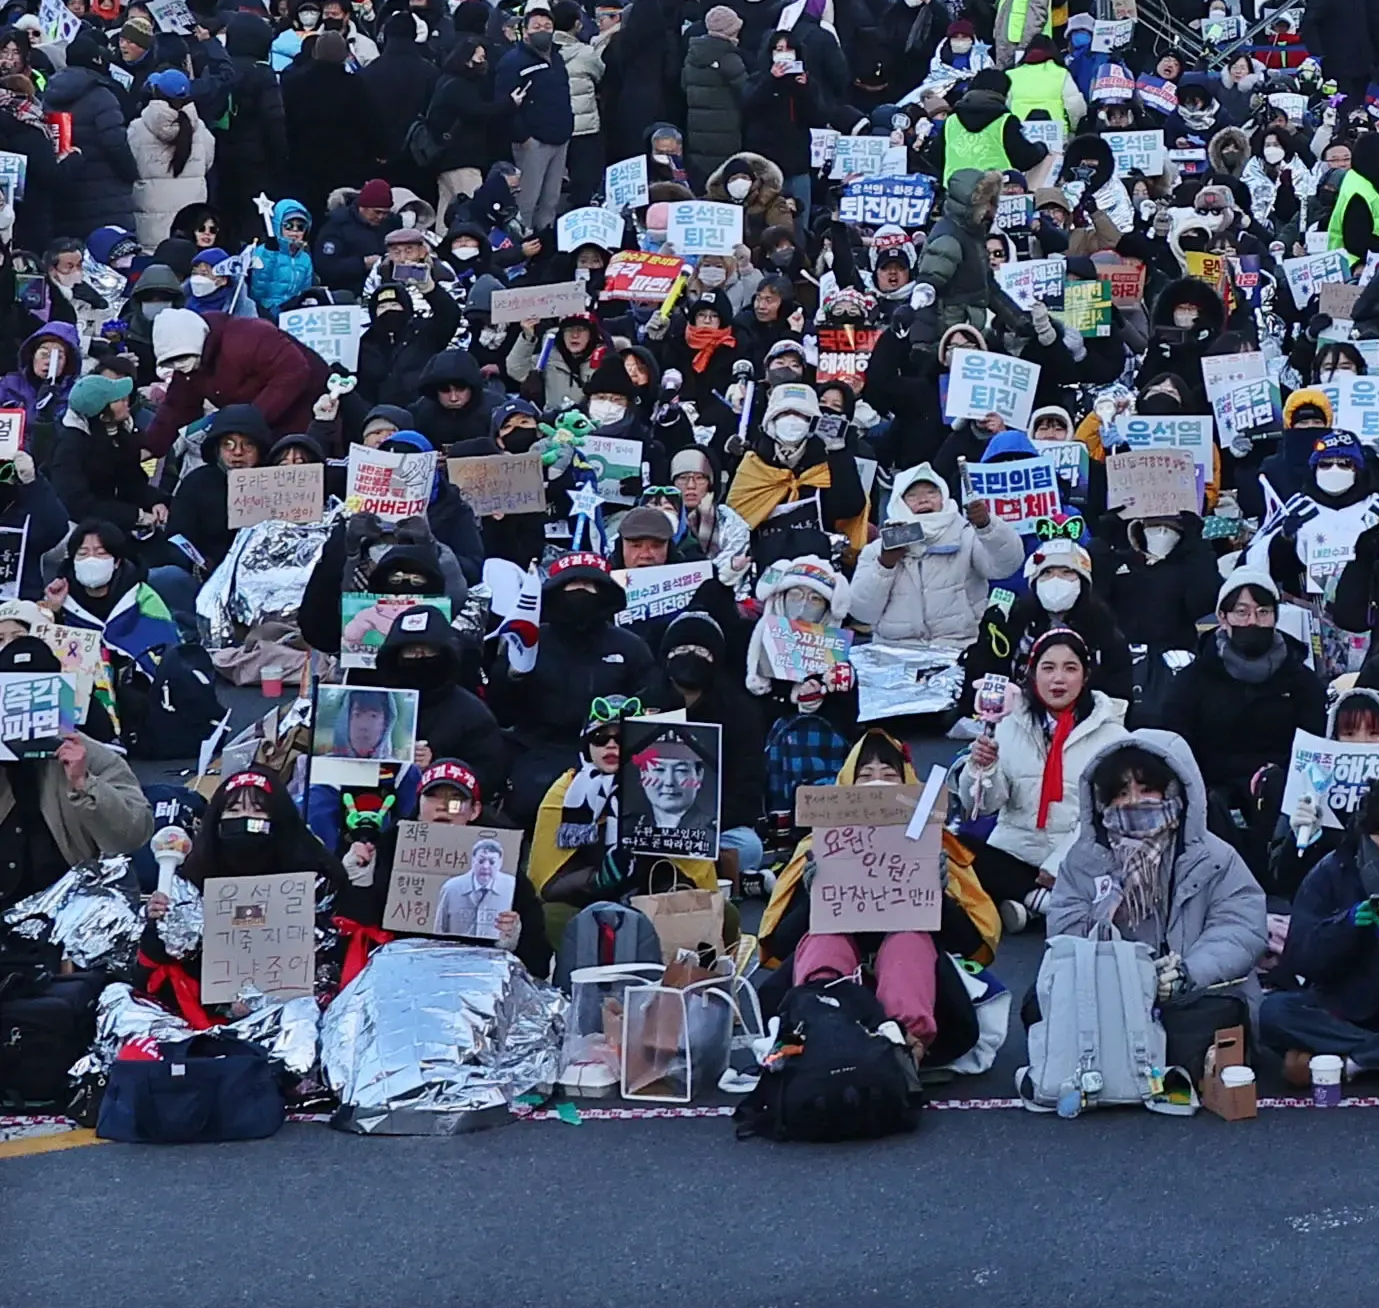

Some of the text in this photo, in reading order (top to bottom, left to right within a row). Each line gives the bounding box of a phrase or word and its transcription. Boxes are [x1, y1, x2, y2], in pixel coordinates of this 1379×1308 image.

[1110, 135, 1159, 153] 윤석열
[610, 161, 641, 183] 윤석열
[841, 155, 876, 174] 퇴진
[1115, 152, 1152, 171] 퇴진
[615, 183, 636, 203] 퇴진
[563, 213, 618, 232] 윤석열
[675, 206, 735, 227] 윤석열
[840, 195, 931, 228] 퇴진하라
[571, 227, 607, 244] 퇴진
[684, 228, 725, 249] 퇴진
[286, 311, 352, 335] 윤석열
[962, 355, 1032, 384] 윤석열
[969, 384, 1019, 417] 퇴진
[1232, 382, 1271, 406] 즉각
[1236, 401, 1272, 429] 파면
[1126, 420, 1201, 447] 윤석열
[969, 464, 1053, 496] 국민의힘
[3, 676, 62, 712] 즉각
[1, 709, 60, 742] 파면
[822, 826, 875, 859] 요원?
[862, 851, 921, 885] 인원?
